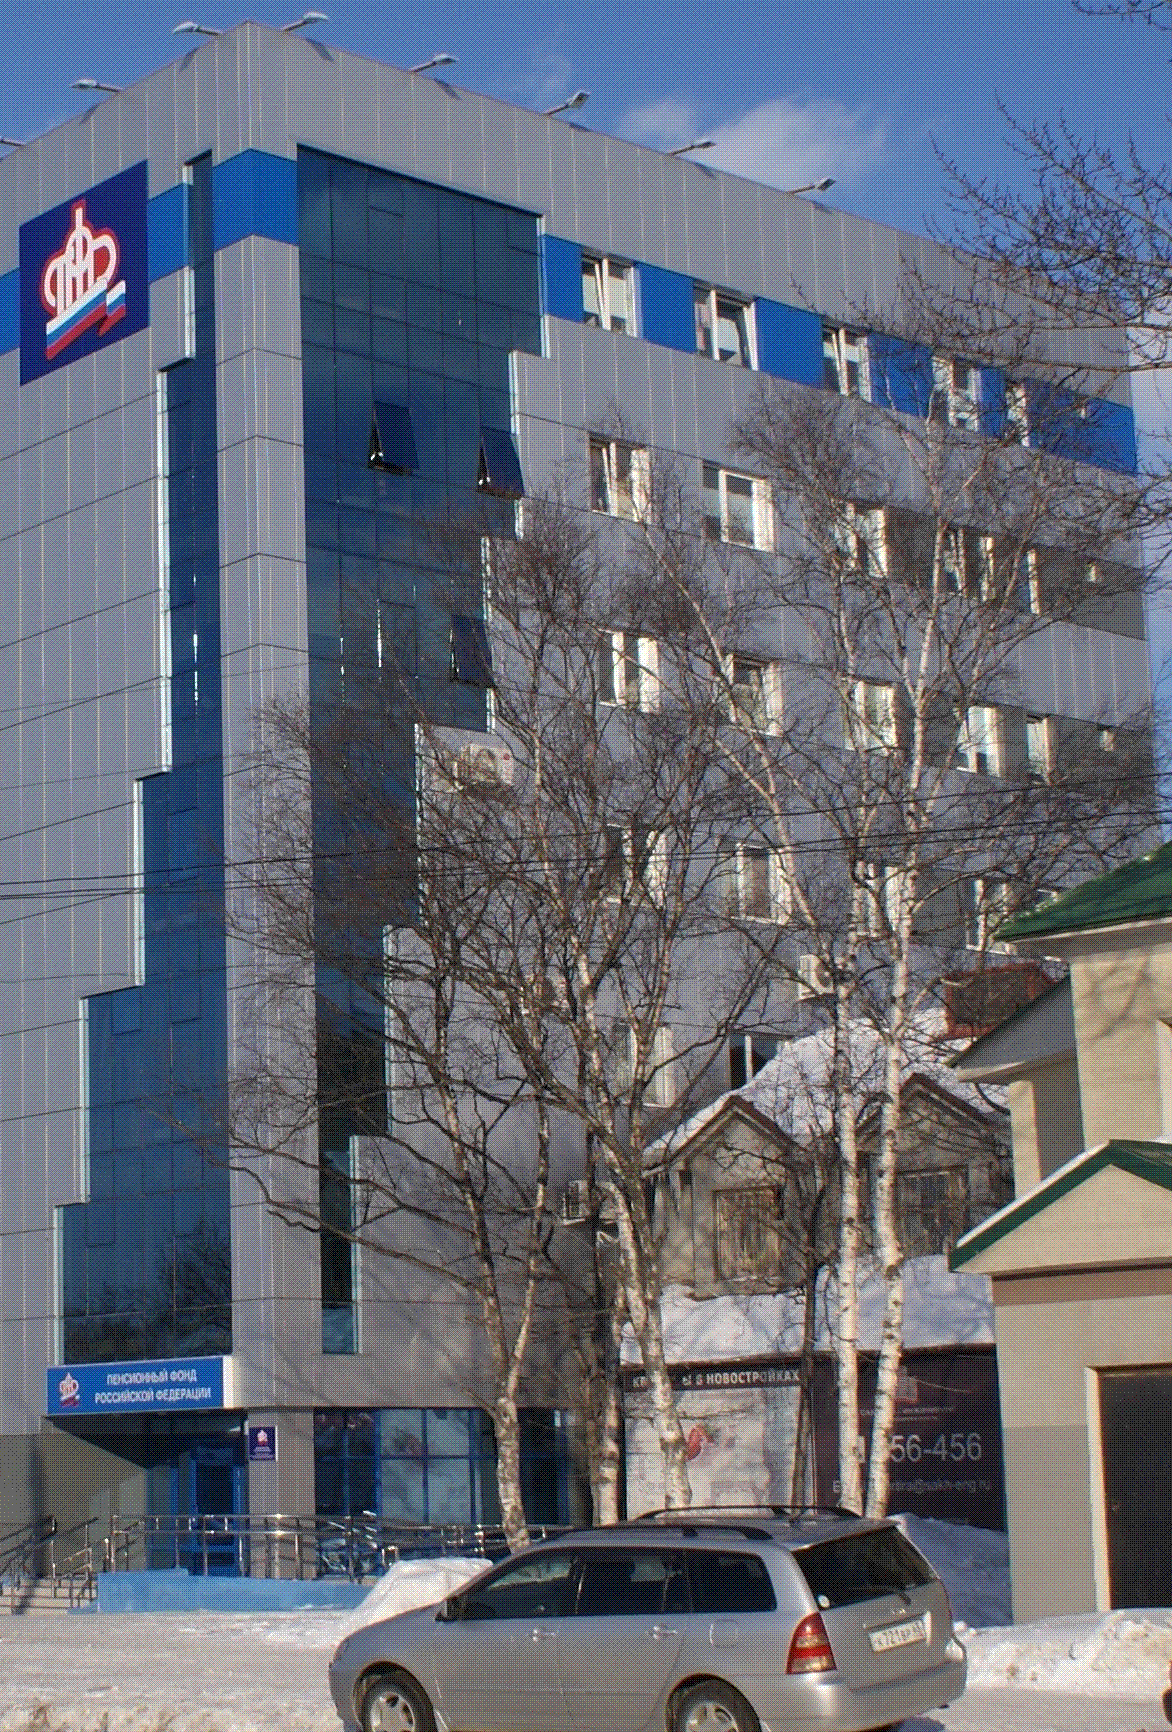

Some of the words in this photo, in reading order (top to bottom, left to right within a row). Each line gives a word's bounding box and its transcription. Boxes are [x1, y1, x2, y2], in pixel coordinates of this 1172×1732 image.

[106, 1368, 168, 1385] ПЕНСИОННЫЙ
[169, 1368, 198, 1383] ФОНД
[706, 1368, 800, 1384] НОВОСТРОЙКАХ
[94, 1387, 154, 1404] РОССИЙСКОЙ
[155, 1386, 212, 1402] ФЕДЕРАЦИИ
[889, 1432, 983, 1463] 56-456
